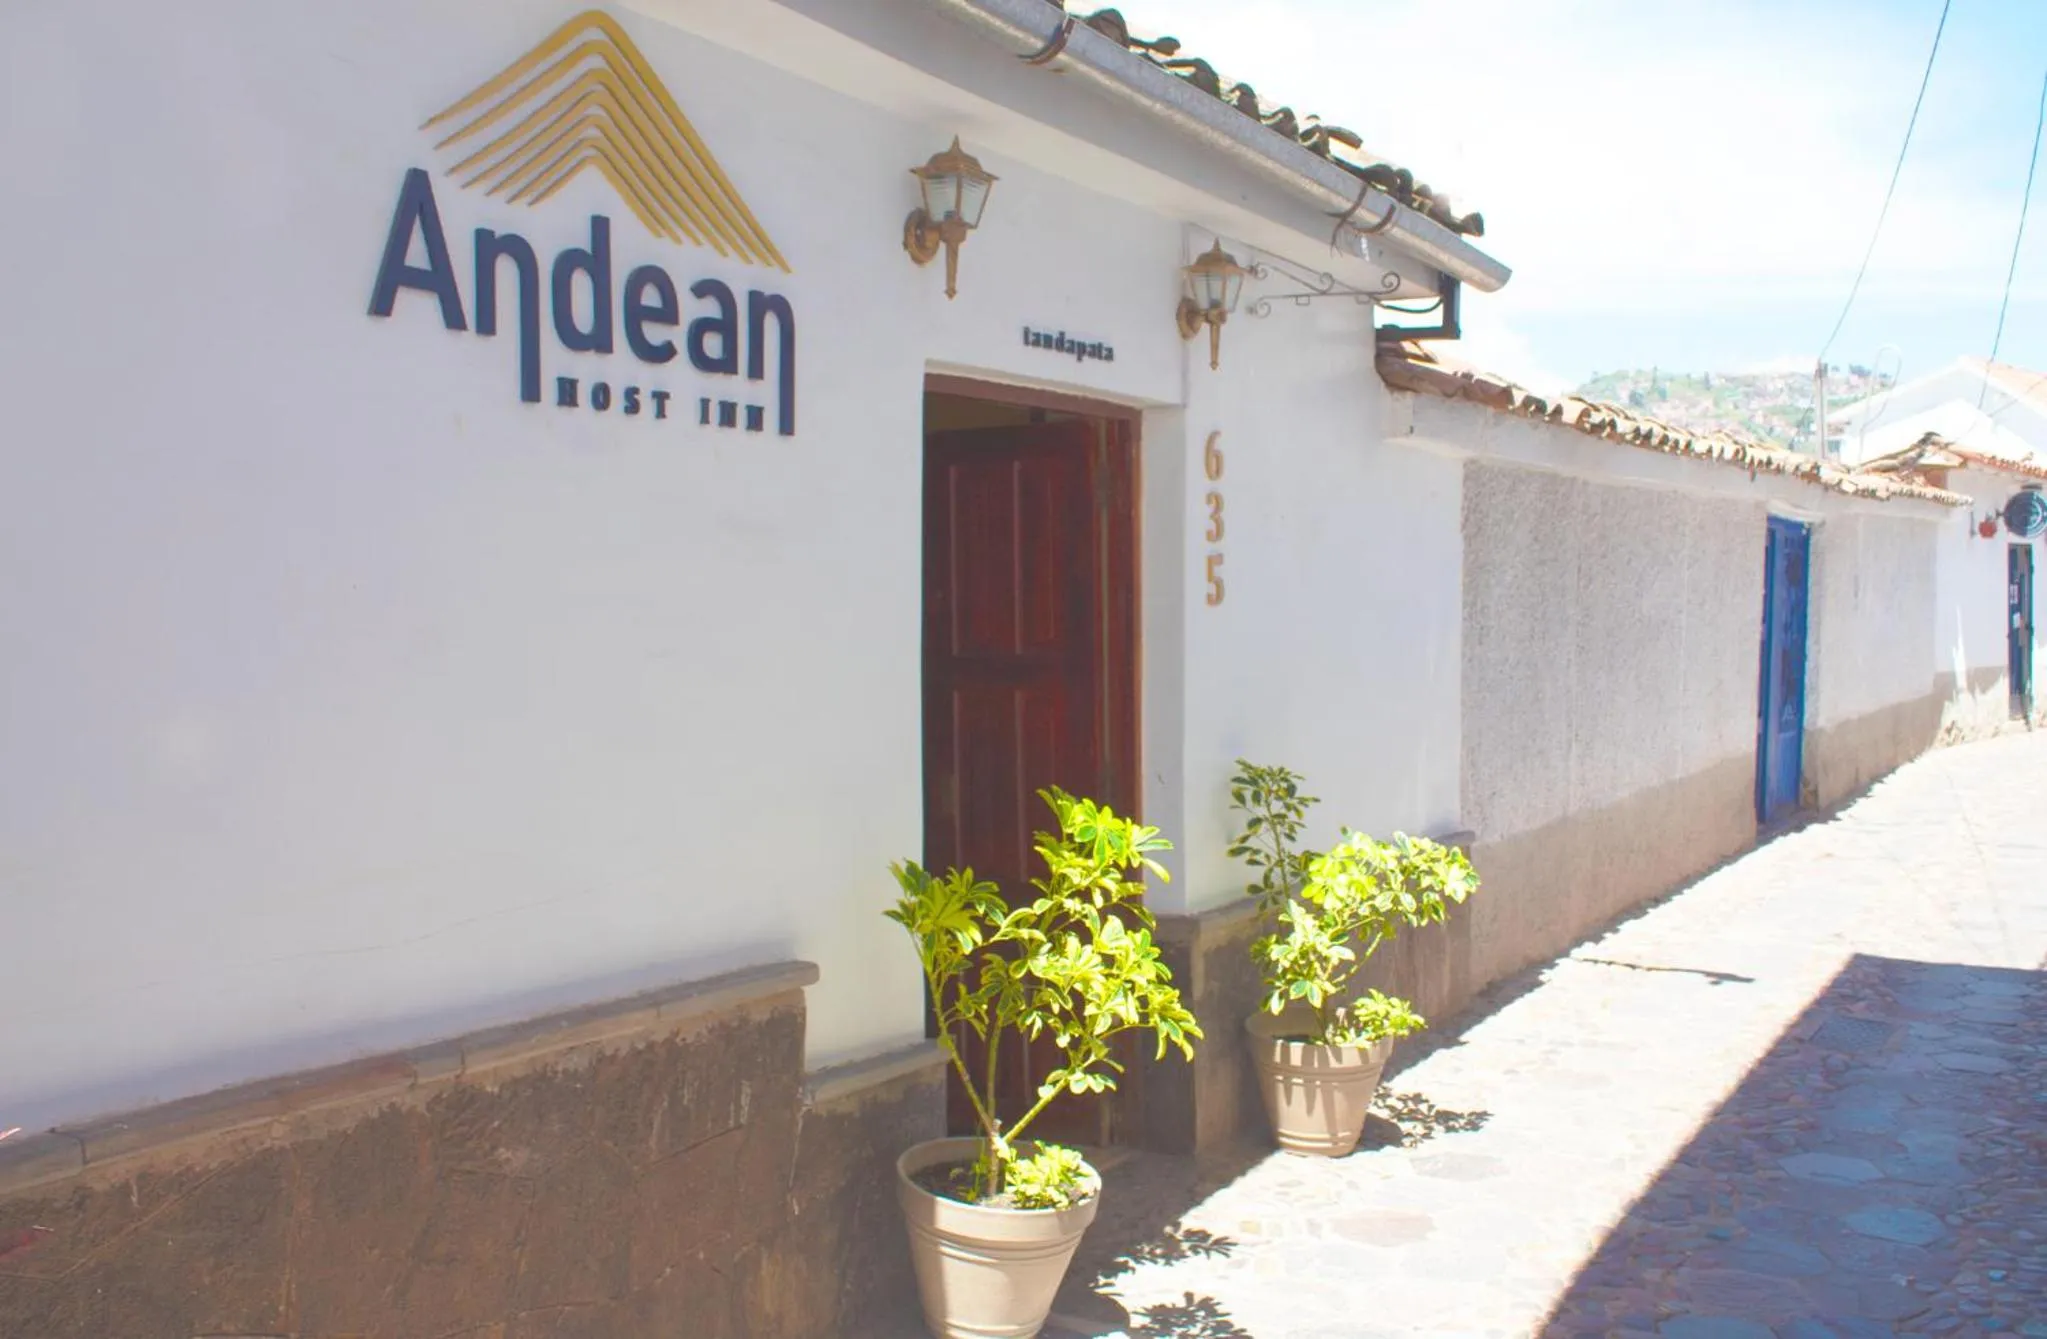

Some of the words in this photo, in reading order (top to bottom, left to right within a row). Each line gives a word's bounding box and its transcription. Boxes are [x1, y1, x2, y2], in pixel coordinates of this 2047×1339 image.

[367, 167, 796, 436] Andean
[1023, 326, 1114, 362] tandapata
[556, 376, 671, 419] HOST
[699, 397, 765, 432] INN
[1204, 430, 1225, 606] 635
